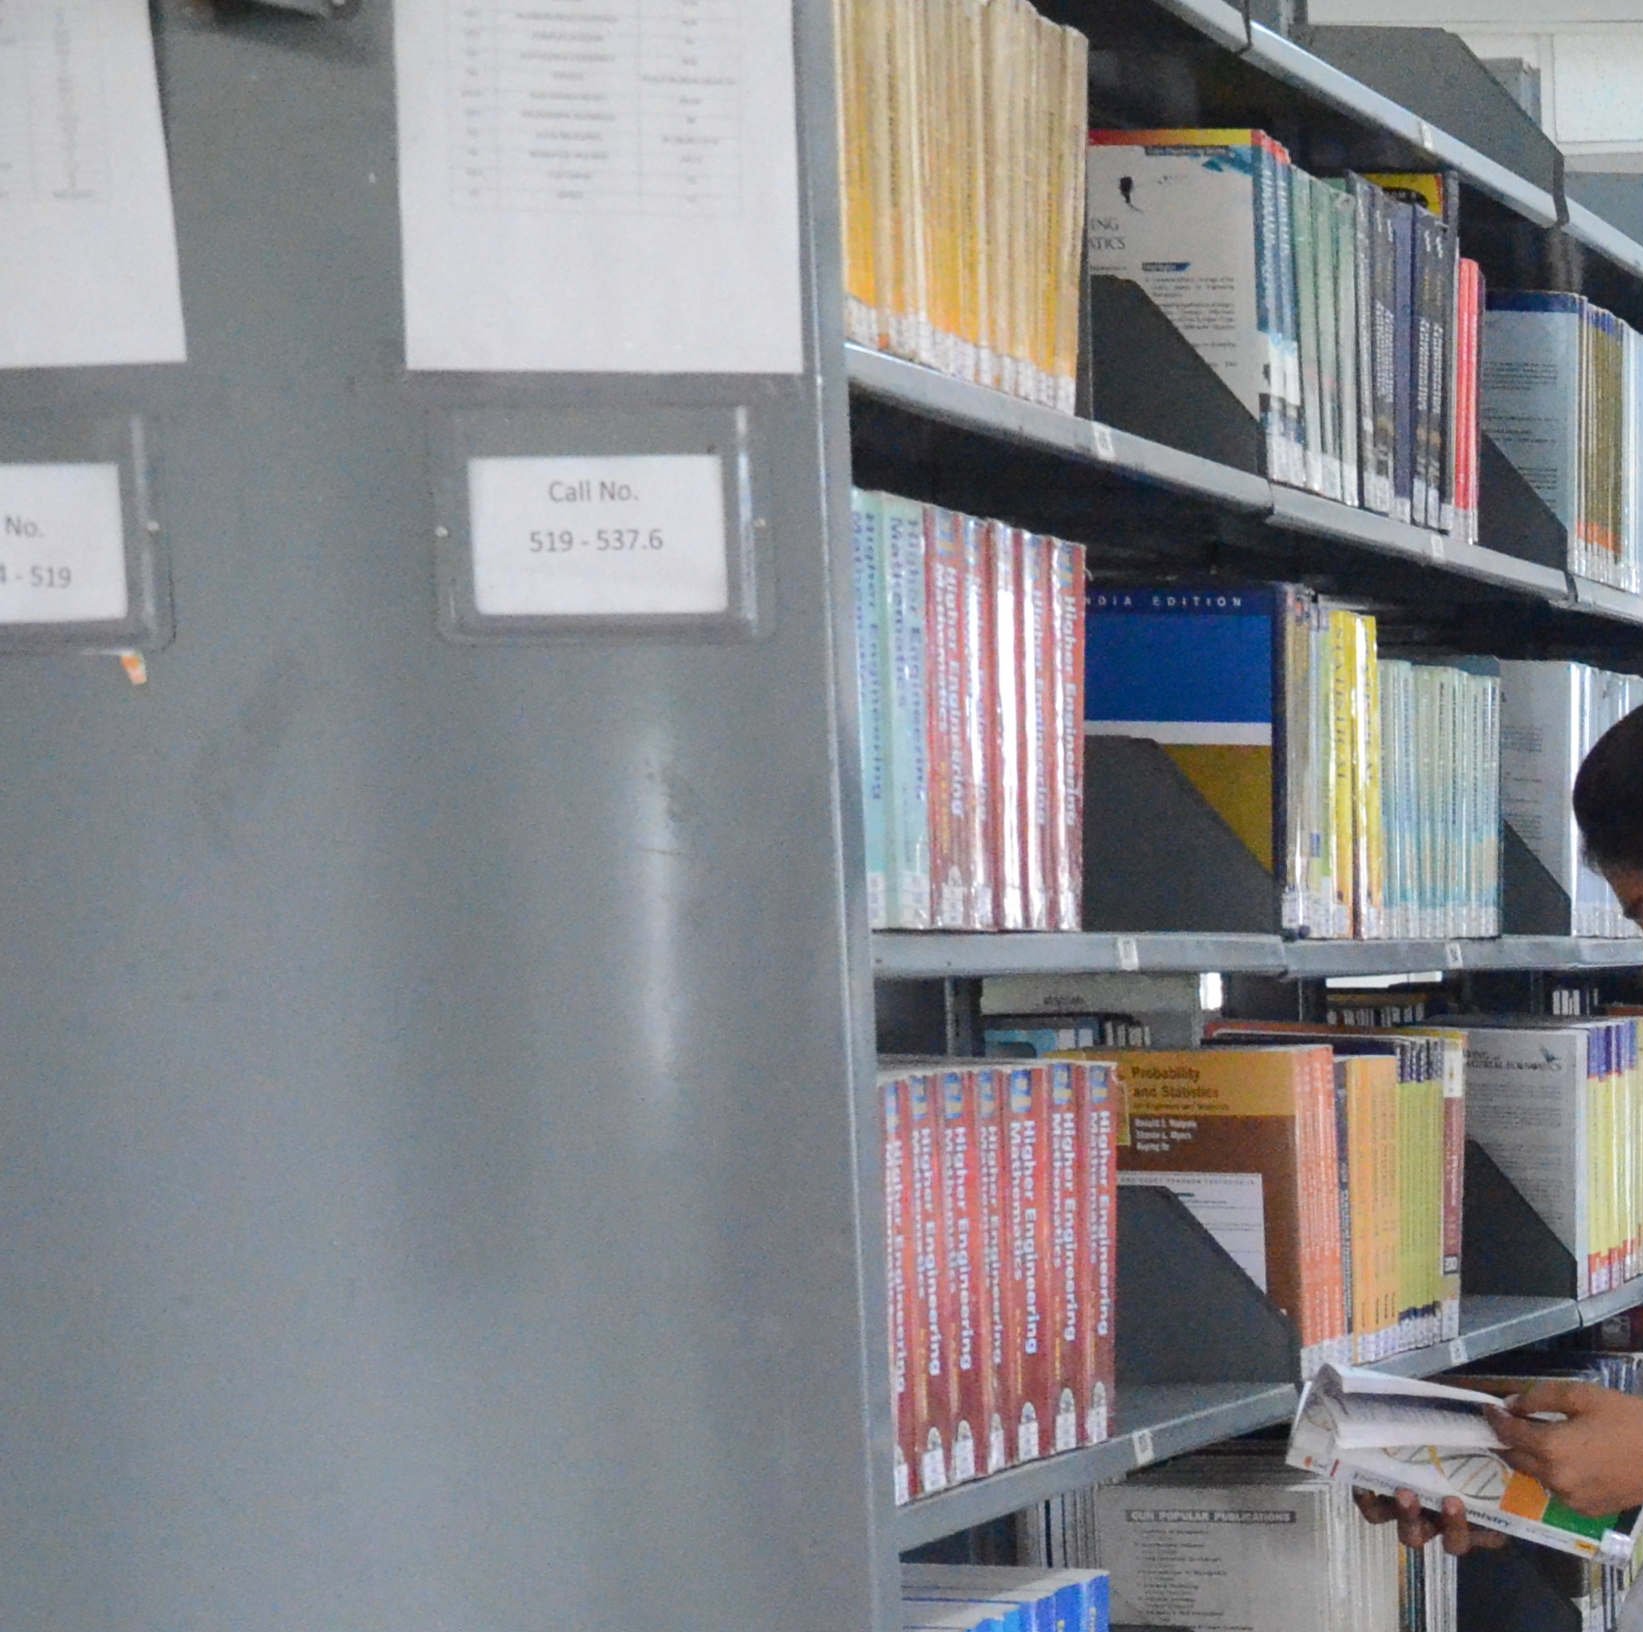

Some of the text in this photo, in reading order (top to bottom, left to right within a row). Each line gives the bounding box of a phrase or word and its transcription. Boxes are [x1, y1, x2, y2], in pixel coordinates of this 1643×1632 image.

[5, 515, 45, 538] No.
[530, 531, 574, 552] 519
[596, 529, 663, 551] 537.6
[549, 481, 639, 503] Call No.
[30, 566, 72, 588] 519
[935, 564, 948, 732] Mathematics
[1152, 596, 1242, 607] EDITION
[946, 566, 964, 818] Higher Engineering
[1064, 595, 1077, 826] Higher Engineering
[1131, 1067, 1200, 1083] Probability
[1133, 1086, 1219, 1098] and Statistics
[920, 1128, 941, 1376] Higher Engineering
[954, 1127, 973, 1370] Higher Engineering
[988, 1126, 1004, 1364] Higher Engineering
[1010, 1122, 1023, 1280] Mathematics
[1023, 1121, 1039, 1354] Higher Engineering
[1052, 1113, 1063, 1269] Mathematics
[1063, 1113, 1078, 1341] Higher Engineering
[1097, 1111, 1111, 1335] Higher Engineering
[1131, 1512, 1291, 1522] OUR POPULAR PUBLICATIONS
